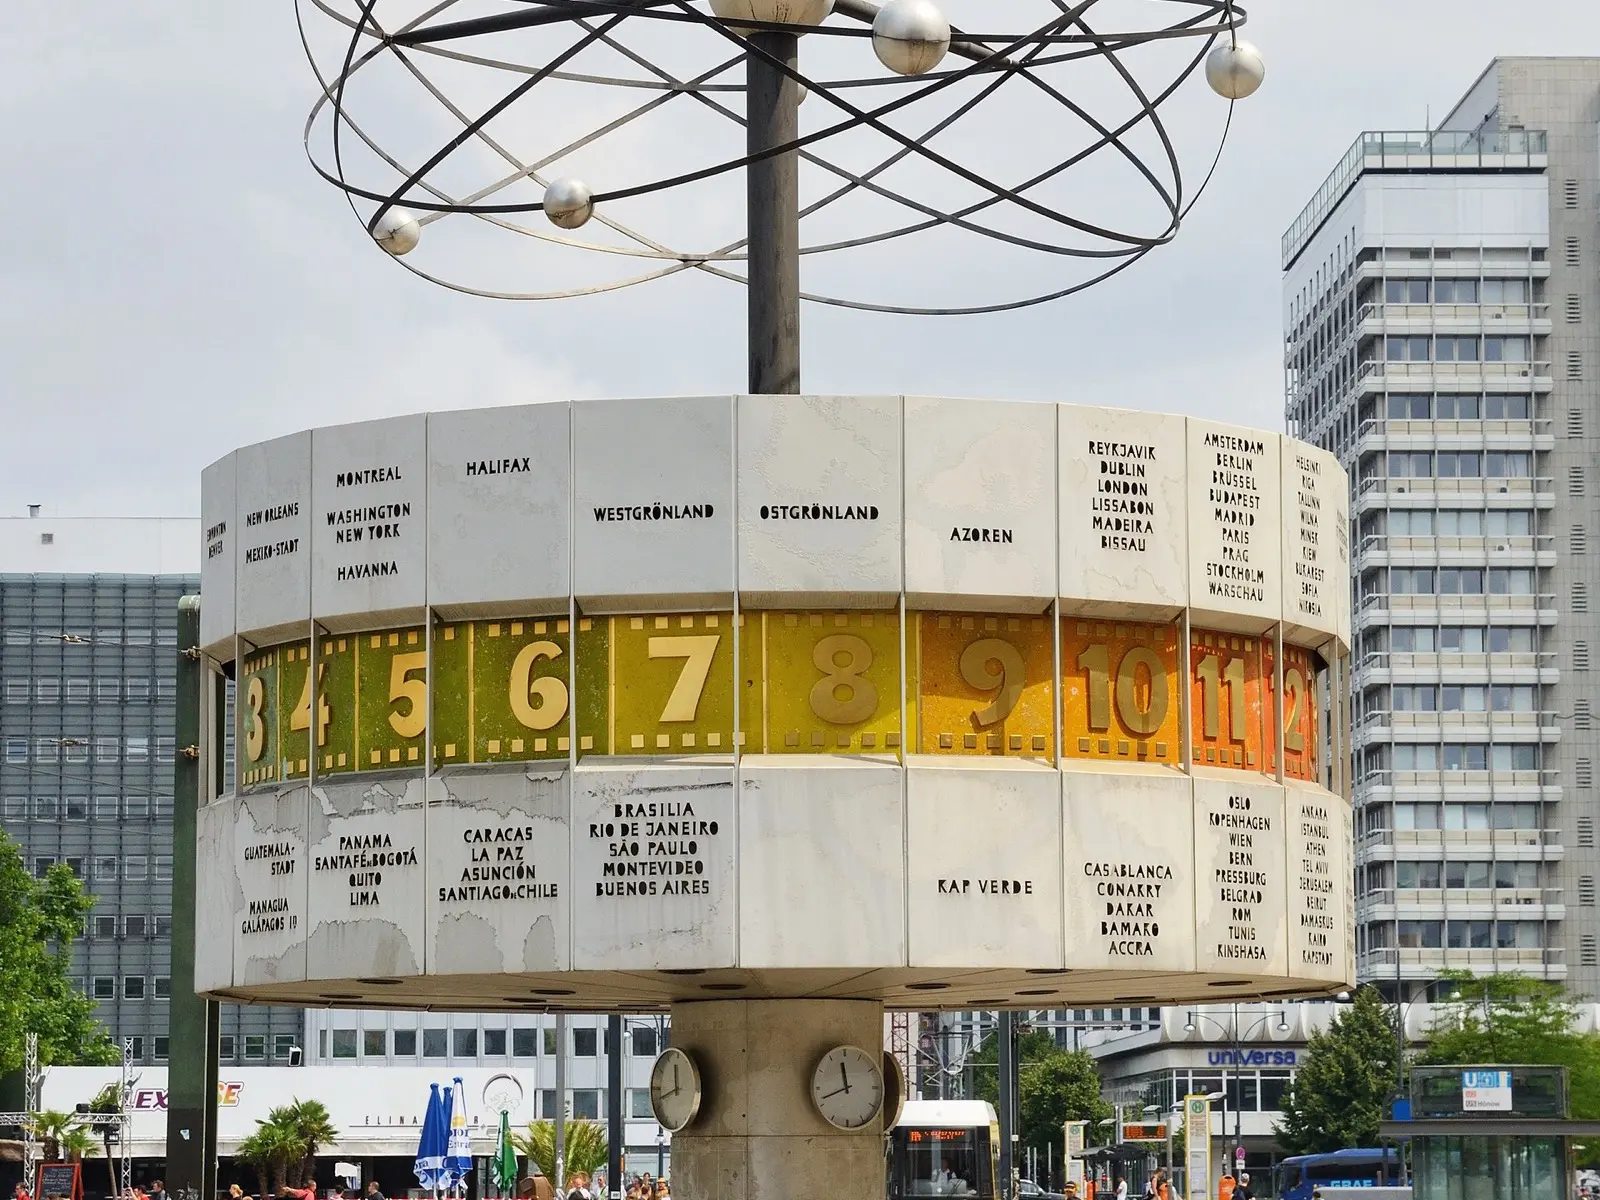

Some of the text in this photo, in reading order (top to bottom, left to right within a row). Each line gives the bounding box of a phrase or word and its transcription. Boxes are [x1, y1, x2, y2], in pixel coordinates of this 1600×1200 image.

[1089, 441, 1156, 460] REYKJAVIK
[1204, 433, 1263, 456] AMSTERDAM
[467, 457, 530, 476] HALIFAX
[1101, 461, 1144, 477] DUBLIN
[1217, 453, 1252, 471] BERLIN
[1296, 455, 1321, 475] HELSINKI
[337, 466, 401, 487] MONTREAL
[1213, 470, 1256, 490] BRÜSSEL
[1302, 475, 1315, 491] RIGA
[1098, 479, 1147, 496] LONDON
[1092, 498, 1153, 515] LISSABON
[1210, 489, 1260, 509] BUDAPEST
[1298, 491, 1320, 510] TALLINN
[247, 502, 299, 527] NEW ORLEANS
[327, 503, 410, 525] WASHINGTON
[593, 502, 714, 522] WESTGRÖNLAND
[760, 503, 879, 520] OSTGRÖNLAND
[1215, 508, 1255, 527] MADRID
[1300, 510, 1318, 528] WILNA
[336, 524, 400, 543] NEW YORK
[1092, 516, 1153, 534] MADEIRA
[950, 527, 1013, 543] AZOREN
[1101, 535, 1145, 551] BISSAU
[1222, 528, 1249, 544] PARIS
[1300, 528, 1318, 545] MINSK
[246, 539, 299, 563] MEXIKO-STADT
[1223, 546, 1248, 562] PRAG
[1302, 546, 1316, 561] KIEW
[338, 561, 398, 580] HAVANNA
[1207, 563, 1264, 584] STOCKHOLM
[1295, 562, 1324, 582] BUKAREST
[1209, 581, 1263, 602] WARSCHAU
[1302, 582, 1318, 599] SOFIA
[1299, 599, 1321, 617] NIKOSIA
[509, 640, 569, 730] 6
[648, 635, 720, 722] 7
[809, 634, 878, 724] 8
[958, 638, 1026, 728] 9
[388, 651, 427, 738] 5
[1077, 644, 1169, 734] 10
[1195, 654, 1246, 741] 11
[290, 663, 330, 746] 4
[246, 677, 264, 762] 3
[614, 802, 695, 818] BRASILIA
[1229, 796, 1250, 810] OSLO
[1209, 812, 1270, 831] KOPENHAGEN
[1301, 804, 1328, 822] ANKARA
[464, 827, 532, 843] CARACAS
[589, 821, 719, 838] RIO DE JANEIRO
[1301, 823, 1329, 840] ISTANBUL
[340, 833, 392, 850] PANAMA
[609, 839, 698, 857] SÃO PAULO
[1229, 832, 1252, 848] WIEN
[472, 846, 524, 862] LA PAZ
[1306, 842, 1326, 857] ATHEN
[272, 860, 295, 875] STADT
[1229, 852, 1252, 866] BERN
[1303, 859, 1329, 875] TEL AVIV
[461, 861, 536, 882] ASUNCIÓN
[603, 860, 704, 877] MONTEVIDEO
[1084, 862, 1172, 880] CASABLANCA
[349, 872, 382, 887] QUITO
[1216, 869, 1267, 886] PRESSBURG
[1299, 877, 1333, 894] JERUSALEM
[596, 880, 709, 897] BUENOS AIRES
[938, 879, 1033, 895] KAP VERDE
[1097, 882, 1161, 898] CONAKRY
[350, 891, 379, 906] LIMA
[1221, 888, 1262, 904] BELGRAD
[1306, 896, 1326, 910] BEIRUT
[250, 898, 289, 915] MANAGUA
[1107, 902, 1153, 917] DAKAR
[1232, 907, 1251, 922] ROM
[242, 915, 284, 934] GALÁPAGOS
[1102, 921, 1159, 937] BAMAKO
[1301, 913, 1333, 930] DAMASKUS
[1229, 926, 1255, 941] TUNIS
[1308, 932, 1326, 947] KAIRO
[1109, 941, 1153, 956] ACCRA
[1217, 944, 1266, 960] KINSHASA
[1302, 950, 1332, 966] KAPSTADT
[1208, 1050, 1296, 1066] universa
